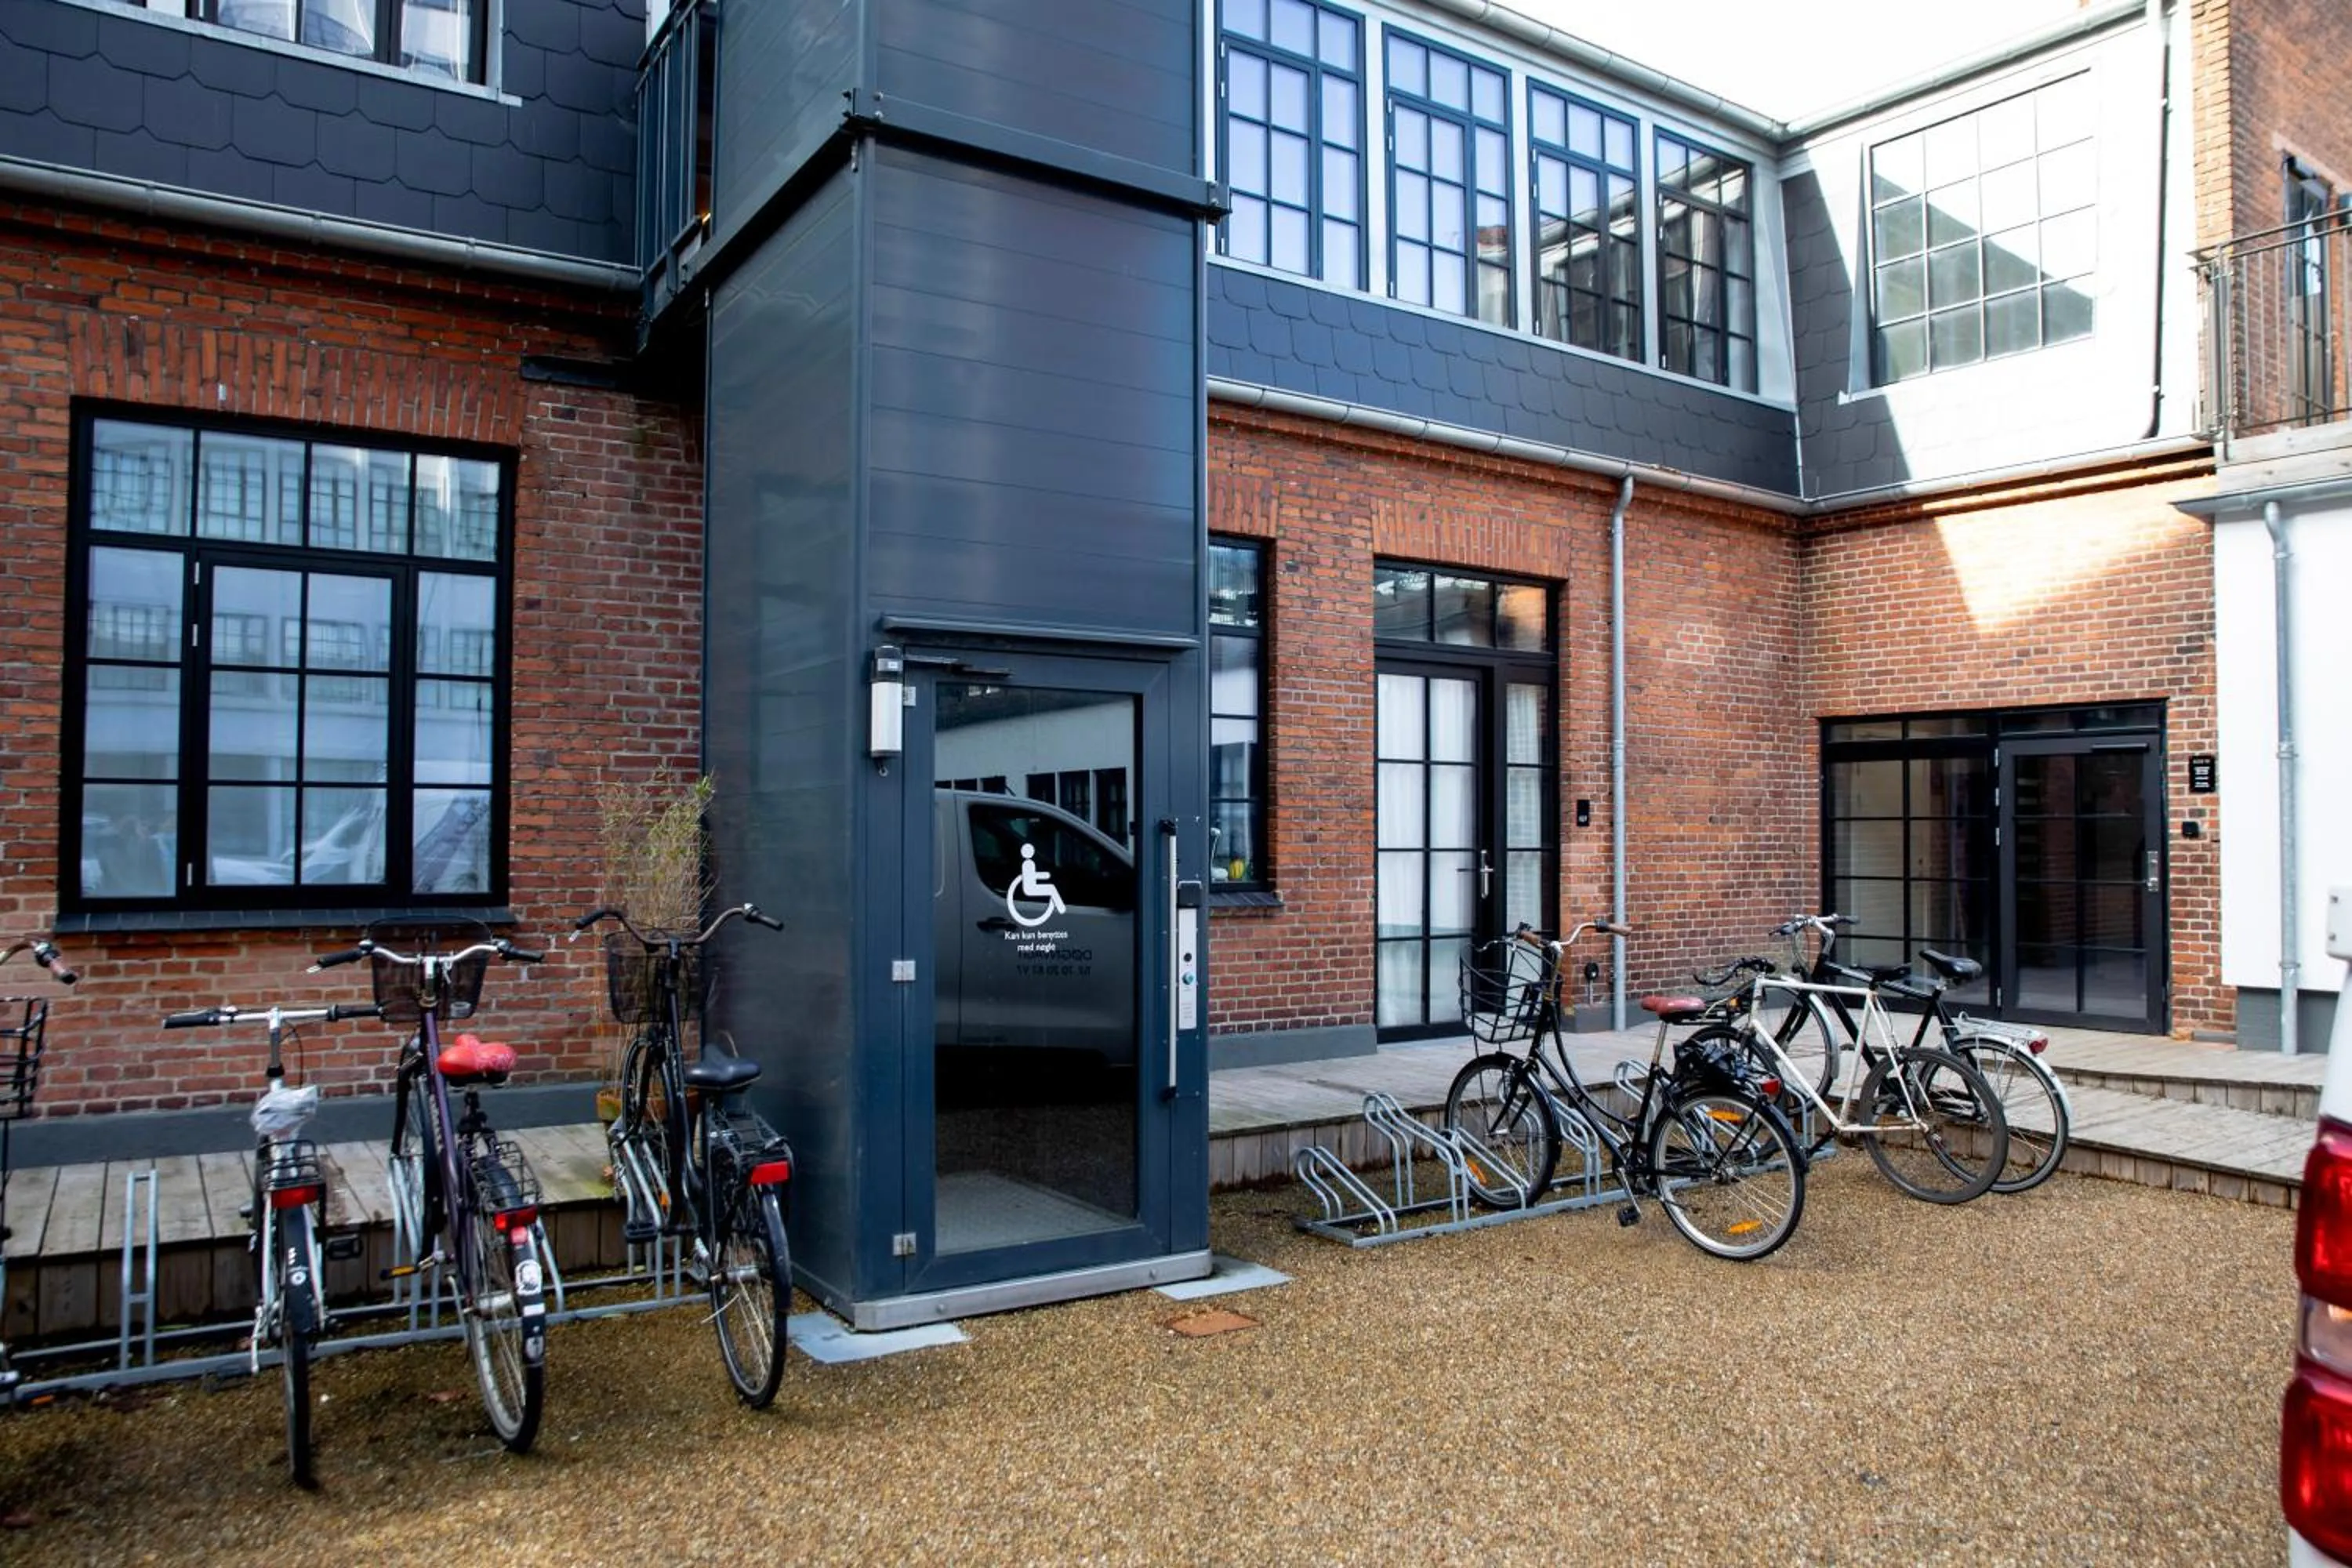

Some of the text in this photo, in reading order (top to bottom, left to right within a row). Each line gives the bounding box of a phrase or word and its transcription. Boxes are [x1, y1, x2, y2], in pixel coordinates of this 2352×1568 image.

[1004, 931, 1019, 940] Kan
[1022, 931, 1036, 940] kun
[1017, 942, 1034, 951] med
